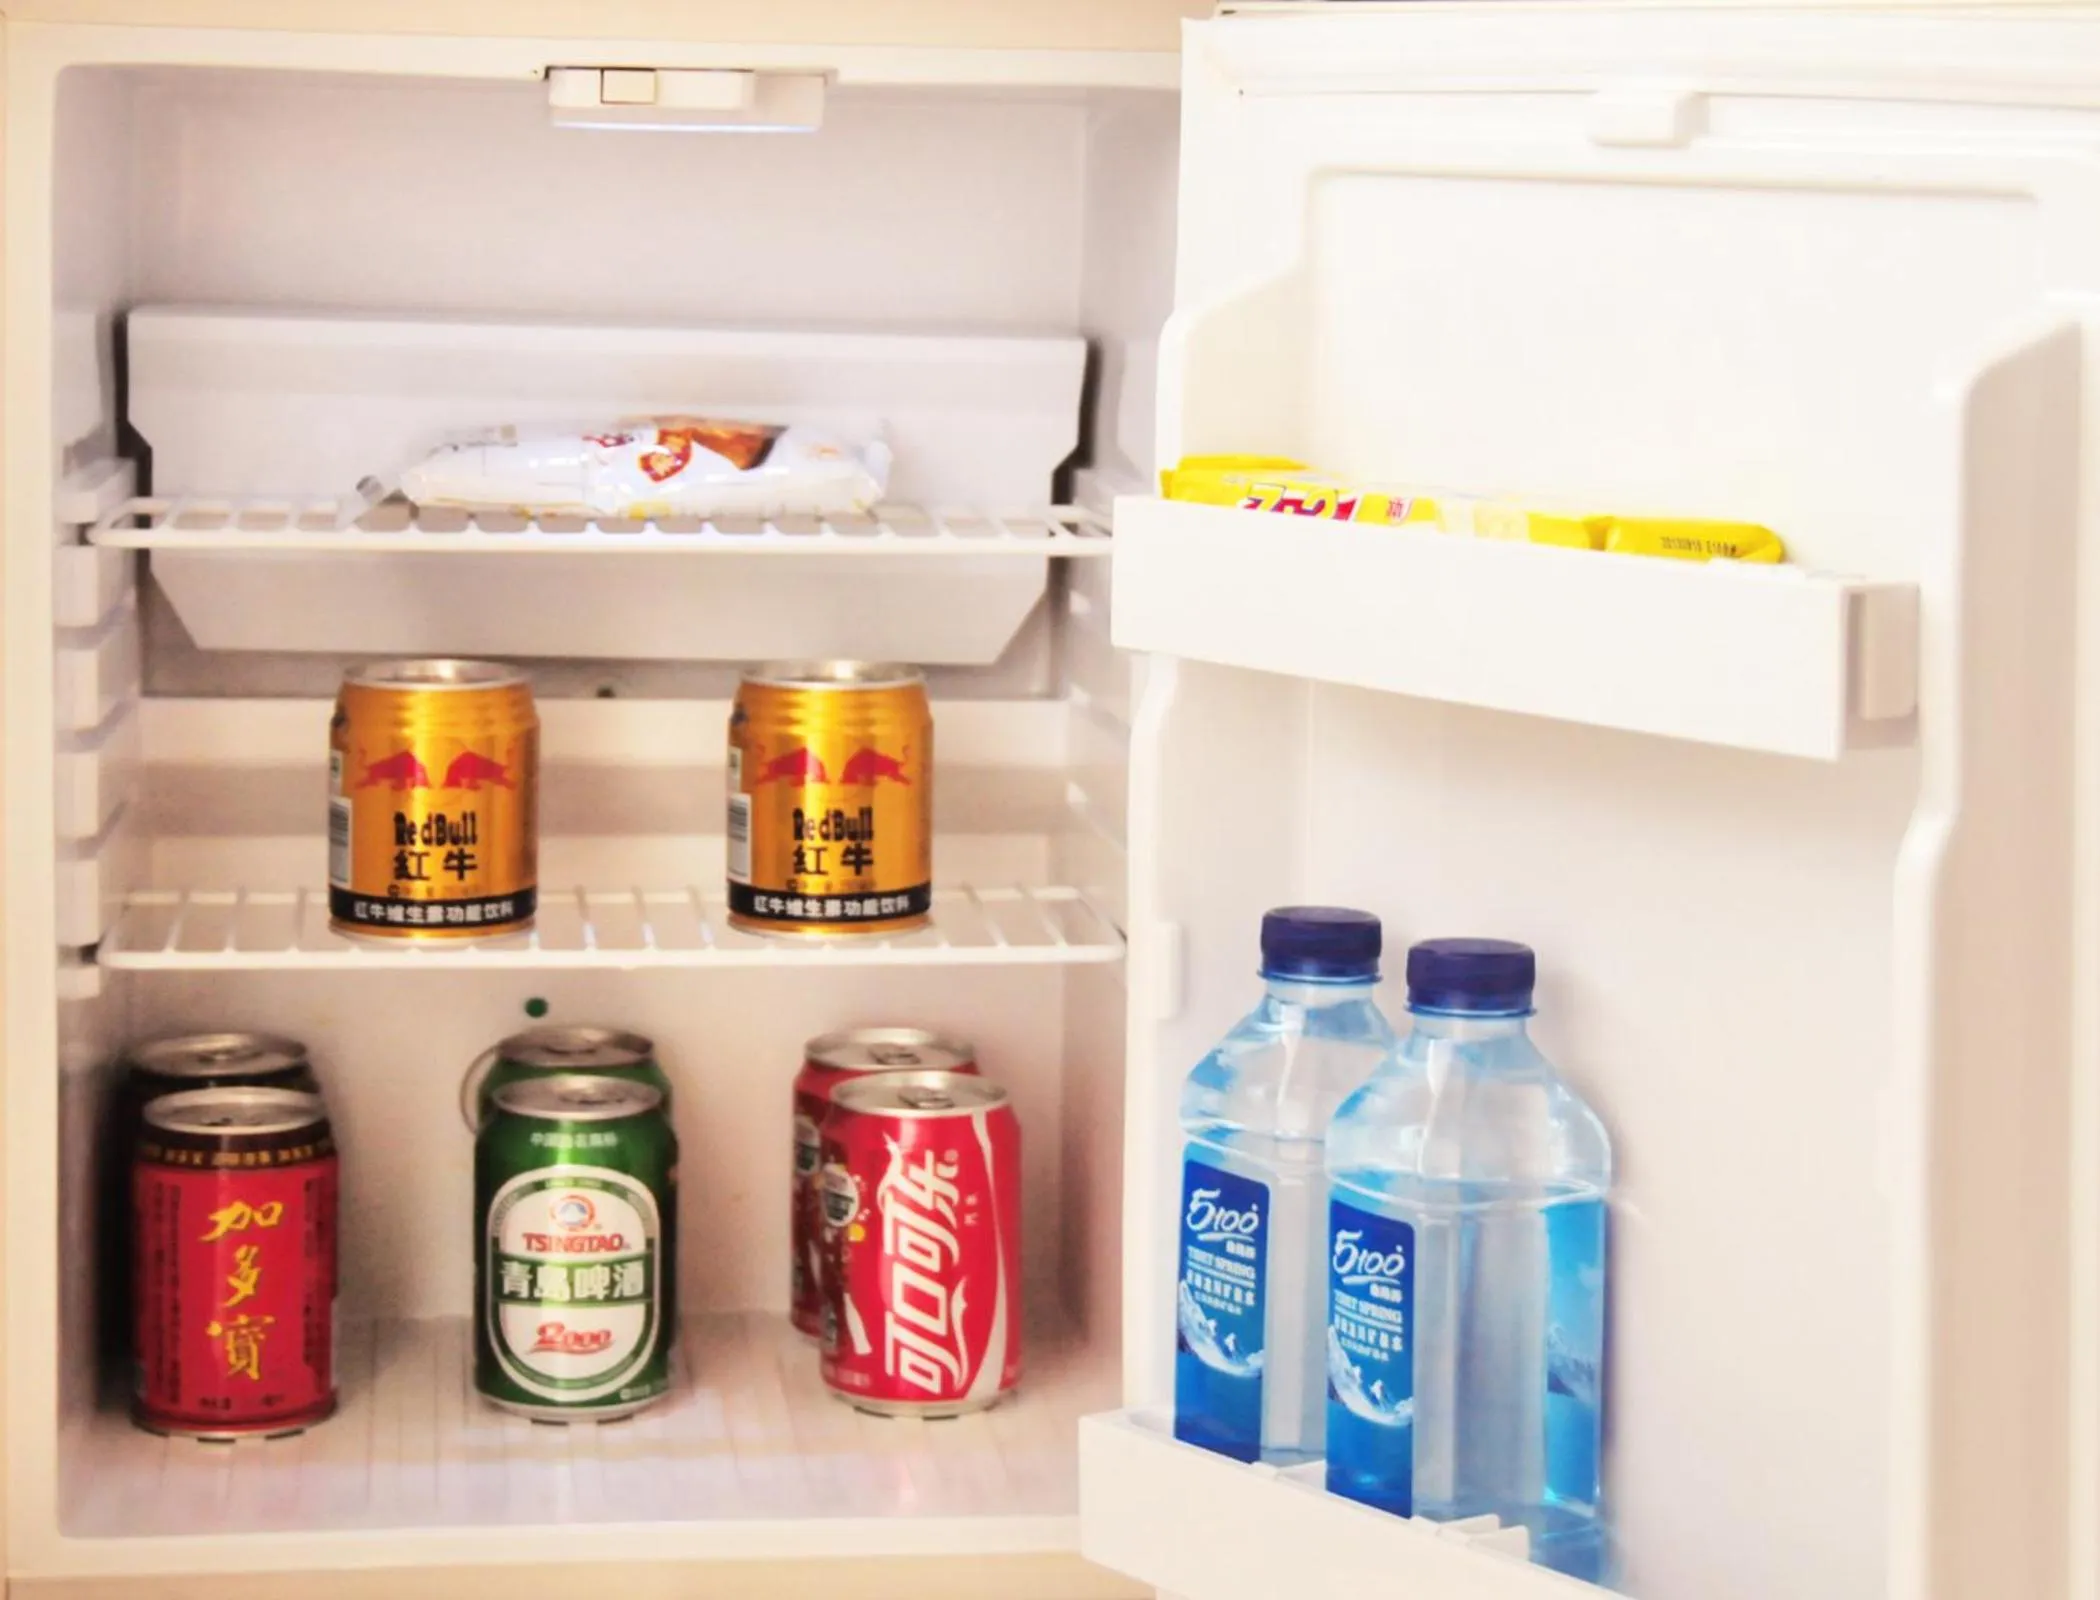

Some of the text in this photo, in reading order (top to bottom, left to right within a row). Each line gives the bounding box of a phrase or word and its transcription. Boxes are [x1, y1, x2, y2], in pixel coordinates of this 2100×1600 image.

[393, 848, 478, 881] 红牛
[792, 843, 874, 876] 红牛
[1186, 1188, 1259, 1233] 5100
[522, 1233, 623, 1252] TSINGTAO
[1333, 1229, 1405, 1276] 5100
[877, 1132, 965, 1394] 可口可乐
